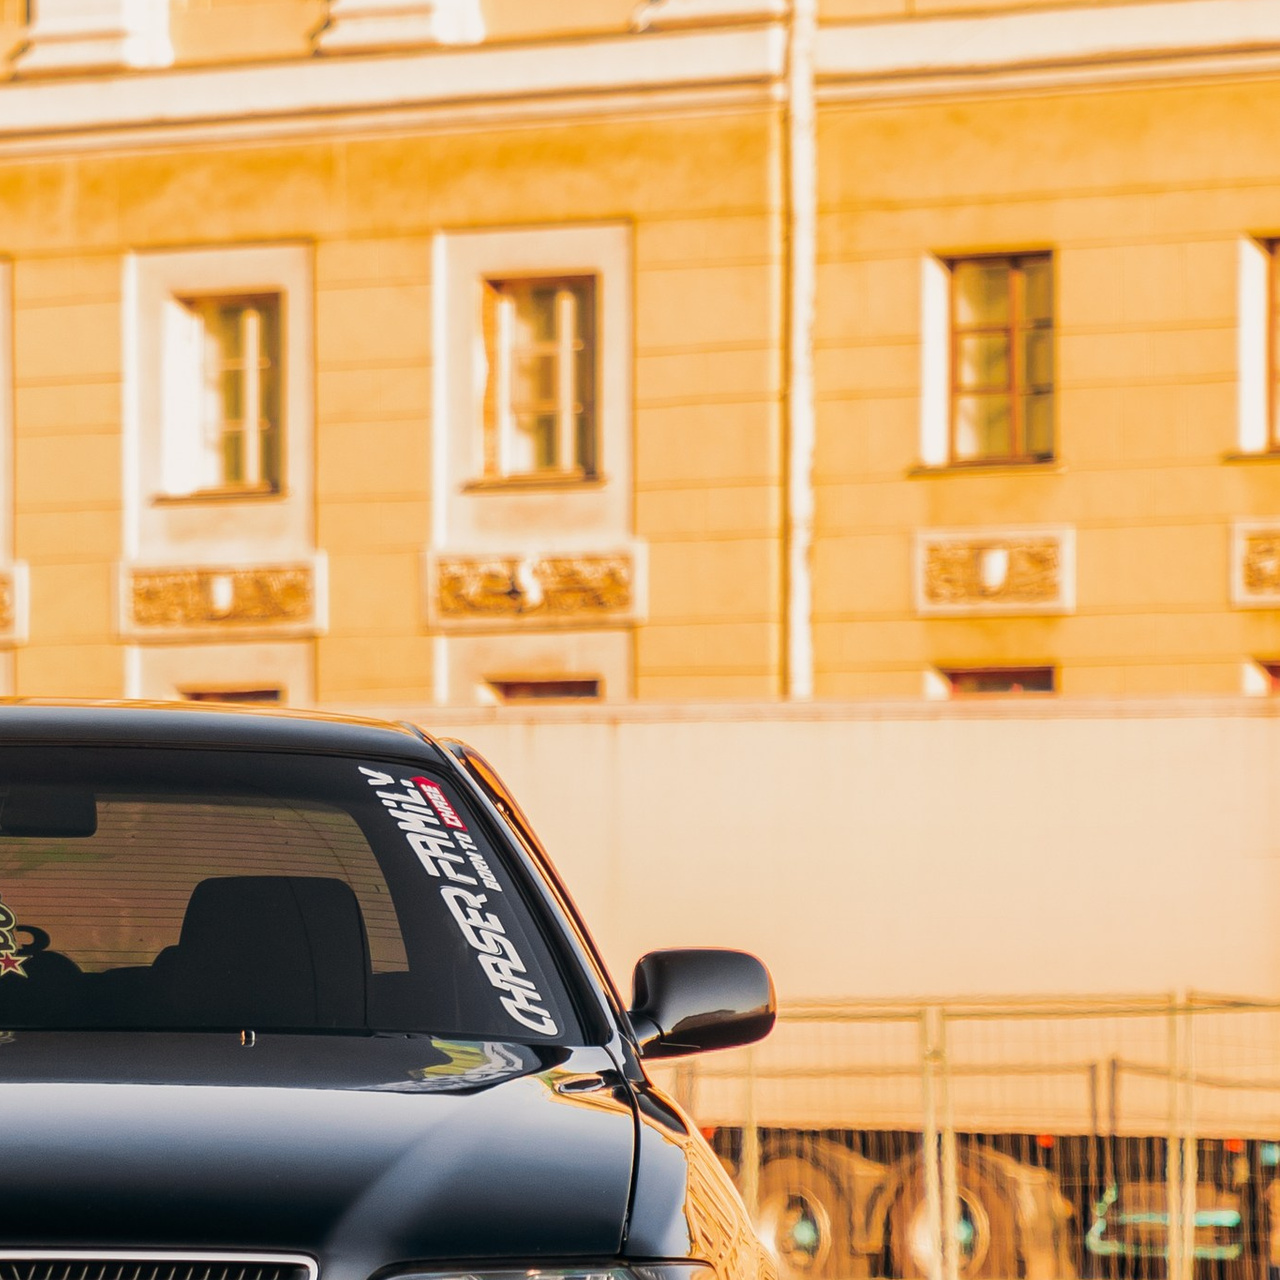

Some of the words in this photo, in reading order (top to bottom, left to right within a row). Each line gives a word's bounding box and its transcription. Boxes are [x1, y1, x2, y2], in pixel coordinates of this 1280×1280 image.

[421, 784, 463, 828] CHASE
[454, 831, 477, 851] TO
[469, 850, 502, 892] BORN
[440, 885, 558, 1036] CHASER
